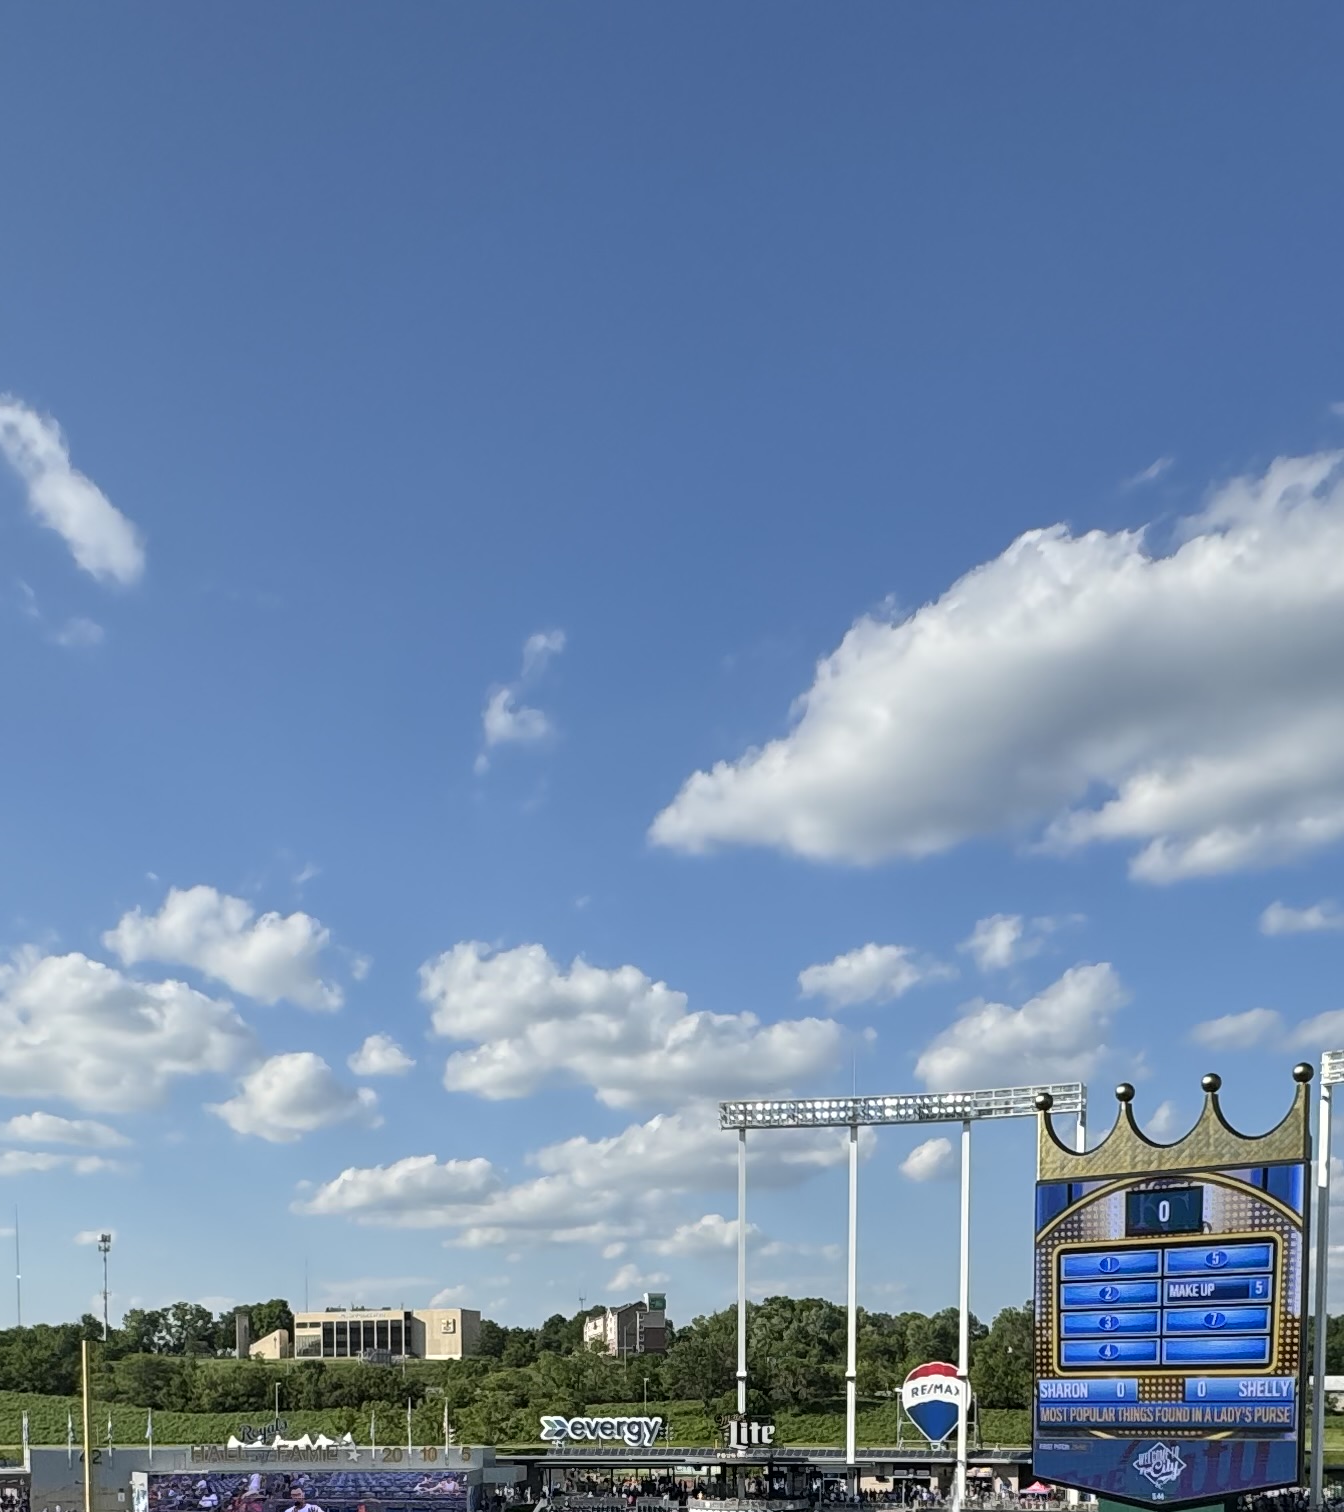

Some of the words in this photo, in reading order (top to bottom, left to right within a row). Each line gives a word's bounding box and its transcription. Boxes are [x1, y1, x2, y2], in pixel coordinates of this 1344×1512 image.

[1159, 1201, 1170, 1222] 0
[1106, 1258, 1112, 1269] 1
[1212, 1252, 1220, 1264] 5
[1105, 1288, 1112, 1300] 2
[1169, 1284, 1199, 1298] MAKE
[1200, 1283, 1215, 1297] UP
[1256, 1282, 1264, 1295] 5
[1105, 1317, 1112, 1328] 3
[1211, 1313, 1218, 1326] 7
[1105, 1346, 1112, 1357] 4
[1040, 1383, 1089, 1399] SHARON
[1117, 1383, 1125, 1397] 0
[1197, 1382, 1206, 1397] 0
[1238, 1381, 1290, 1397] SHELLY
[1040, 1408, 1068, 1422] MOST
[1070, 1407, 1116, 1422] POPULAR
[1117, 1407, 1153, 1422] THINGS
[1156, 1407, 1190, 1422] FOUND
[1191, 1407, 1202, 1422] IN
[1205, 1407, 1212, 1422] A
[1214, 1407, 1252, 1422] LADY'S
[1254, 1407, 1290, 1422] PURSE
[239, 1418, 287, 1443] Royals
[570, 1418, 661, 1446] evergy
[728, 1421, 775, 1450] Lite
[191, 1445, 248, 1463] HALL
[276, 1445, 338, 1463] FAME
[382, 1447, 402, 1462] 20
[422, 1447, 437, 1462] 10
[461, 1447, 471, 1461] 5
